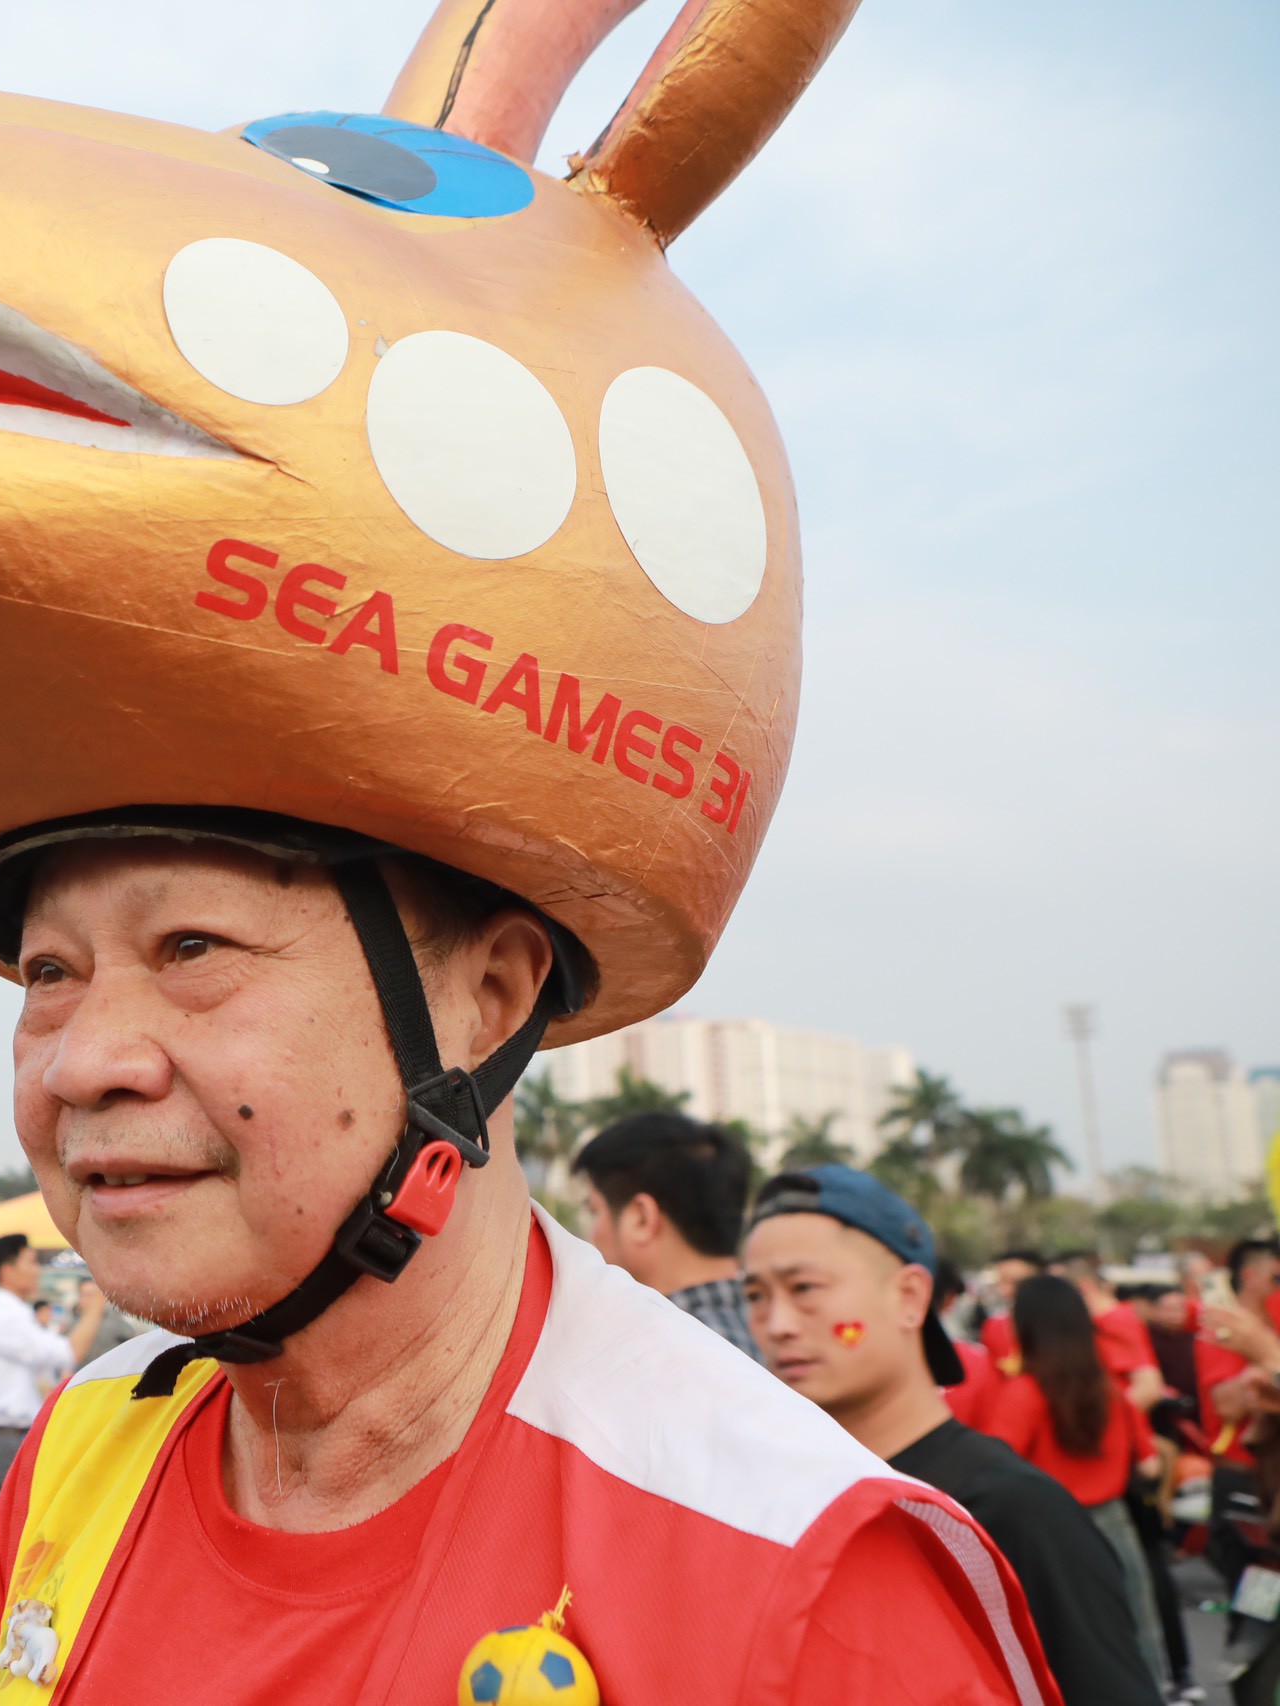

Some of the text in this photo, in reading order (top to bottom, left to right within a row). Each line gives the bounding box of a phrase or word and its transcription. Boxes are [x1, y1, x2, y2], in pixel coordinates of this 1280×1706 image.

[194, 538, 751, 834] SEA GAMES 31
